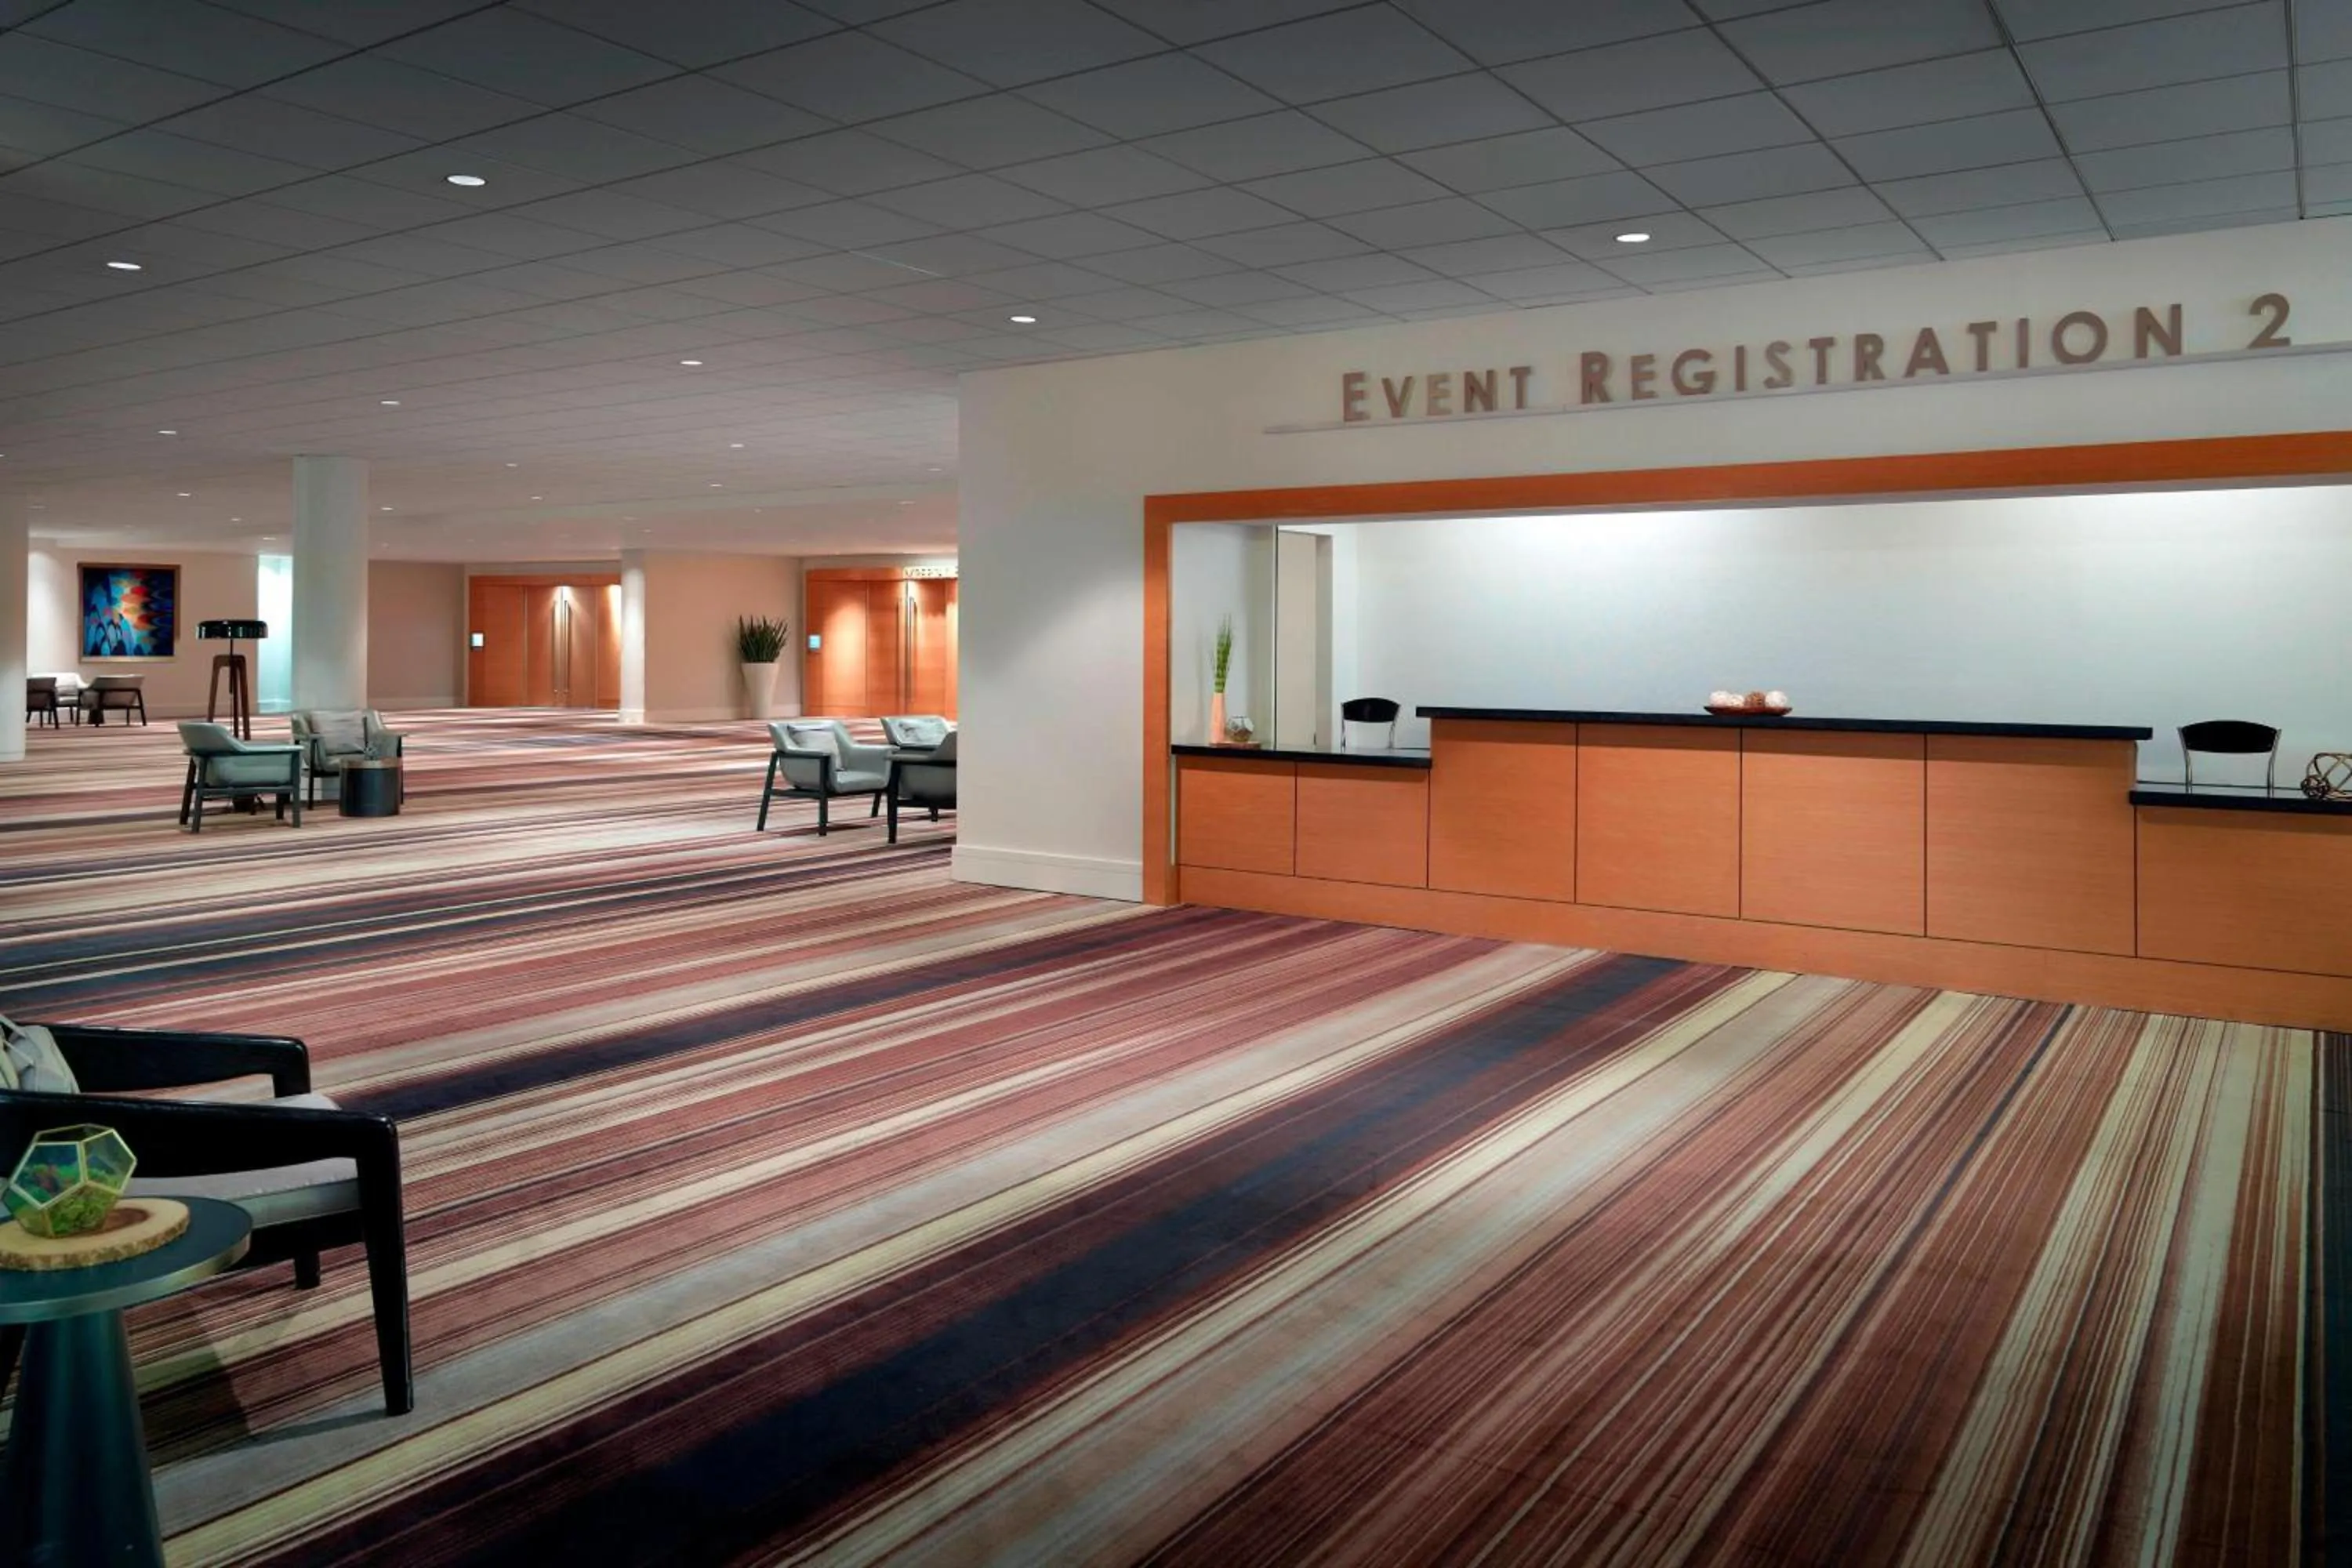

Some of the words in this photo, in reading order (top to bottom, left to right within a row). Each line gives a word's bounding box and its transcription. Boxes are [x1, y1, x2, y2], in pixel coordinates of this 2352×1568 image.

[1342, 365, 1533, 423] EVENT
[1581, 303, 2183, 405] REGISTRATION
[2247, 293, 2291, 350] 2
